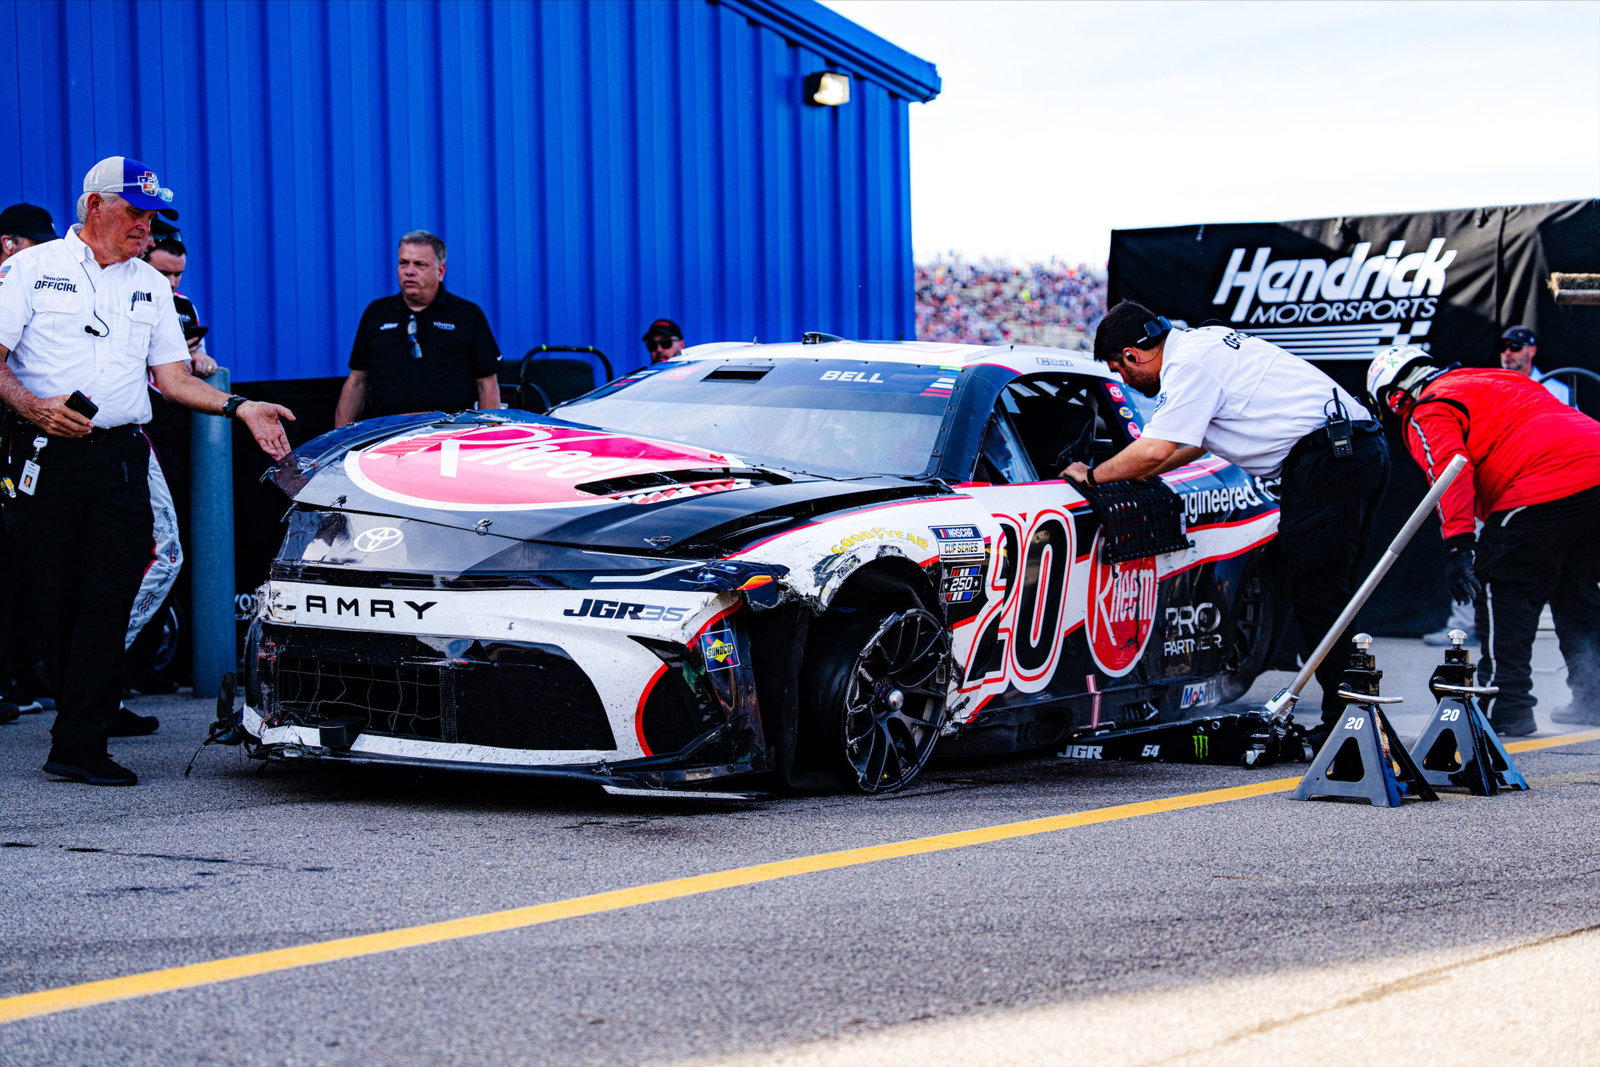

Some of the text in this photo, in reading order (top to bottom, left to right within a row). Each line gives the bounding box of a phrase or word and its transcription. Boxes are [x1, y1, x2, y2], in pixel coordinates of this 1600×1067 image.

[34, 280, 78, 293] OFFICIAL
[1212, 238, 1458, 322] Hendrick
[1250, 297, 1439, 325] MOTORSPORTS
[820, 370, 884, 384] BELL
[1180, 478, 1264, 523] ngineered
[831, 526, 929, 553] GOODYEAR
[948, 527, 975, 538] NASCAR
[944, 542, 979, 554] CUP SERIES
[950, 576, 974, 592] 250
[272, 591, 438, 620] AMRY
[964, 512, 1070, 688] 20
[1165, 602, 1221, 638] PRO
[707, 644, 732, 658] SUNOCO
[1440, 708, 1460, 721] 20
[1344, 717, 1364, 730] 20
[1057, 745, 1103, 760] JGR
[1141, 745, 1161, 758] 54
